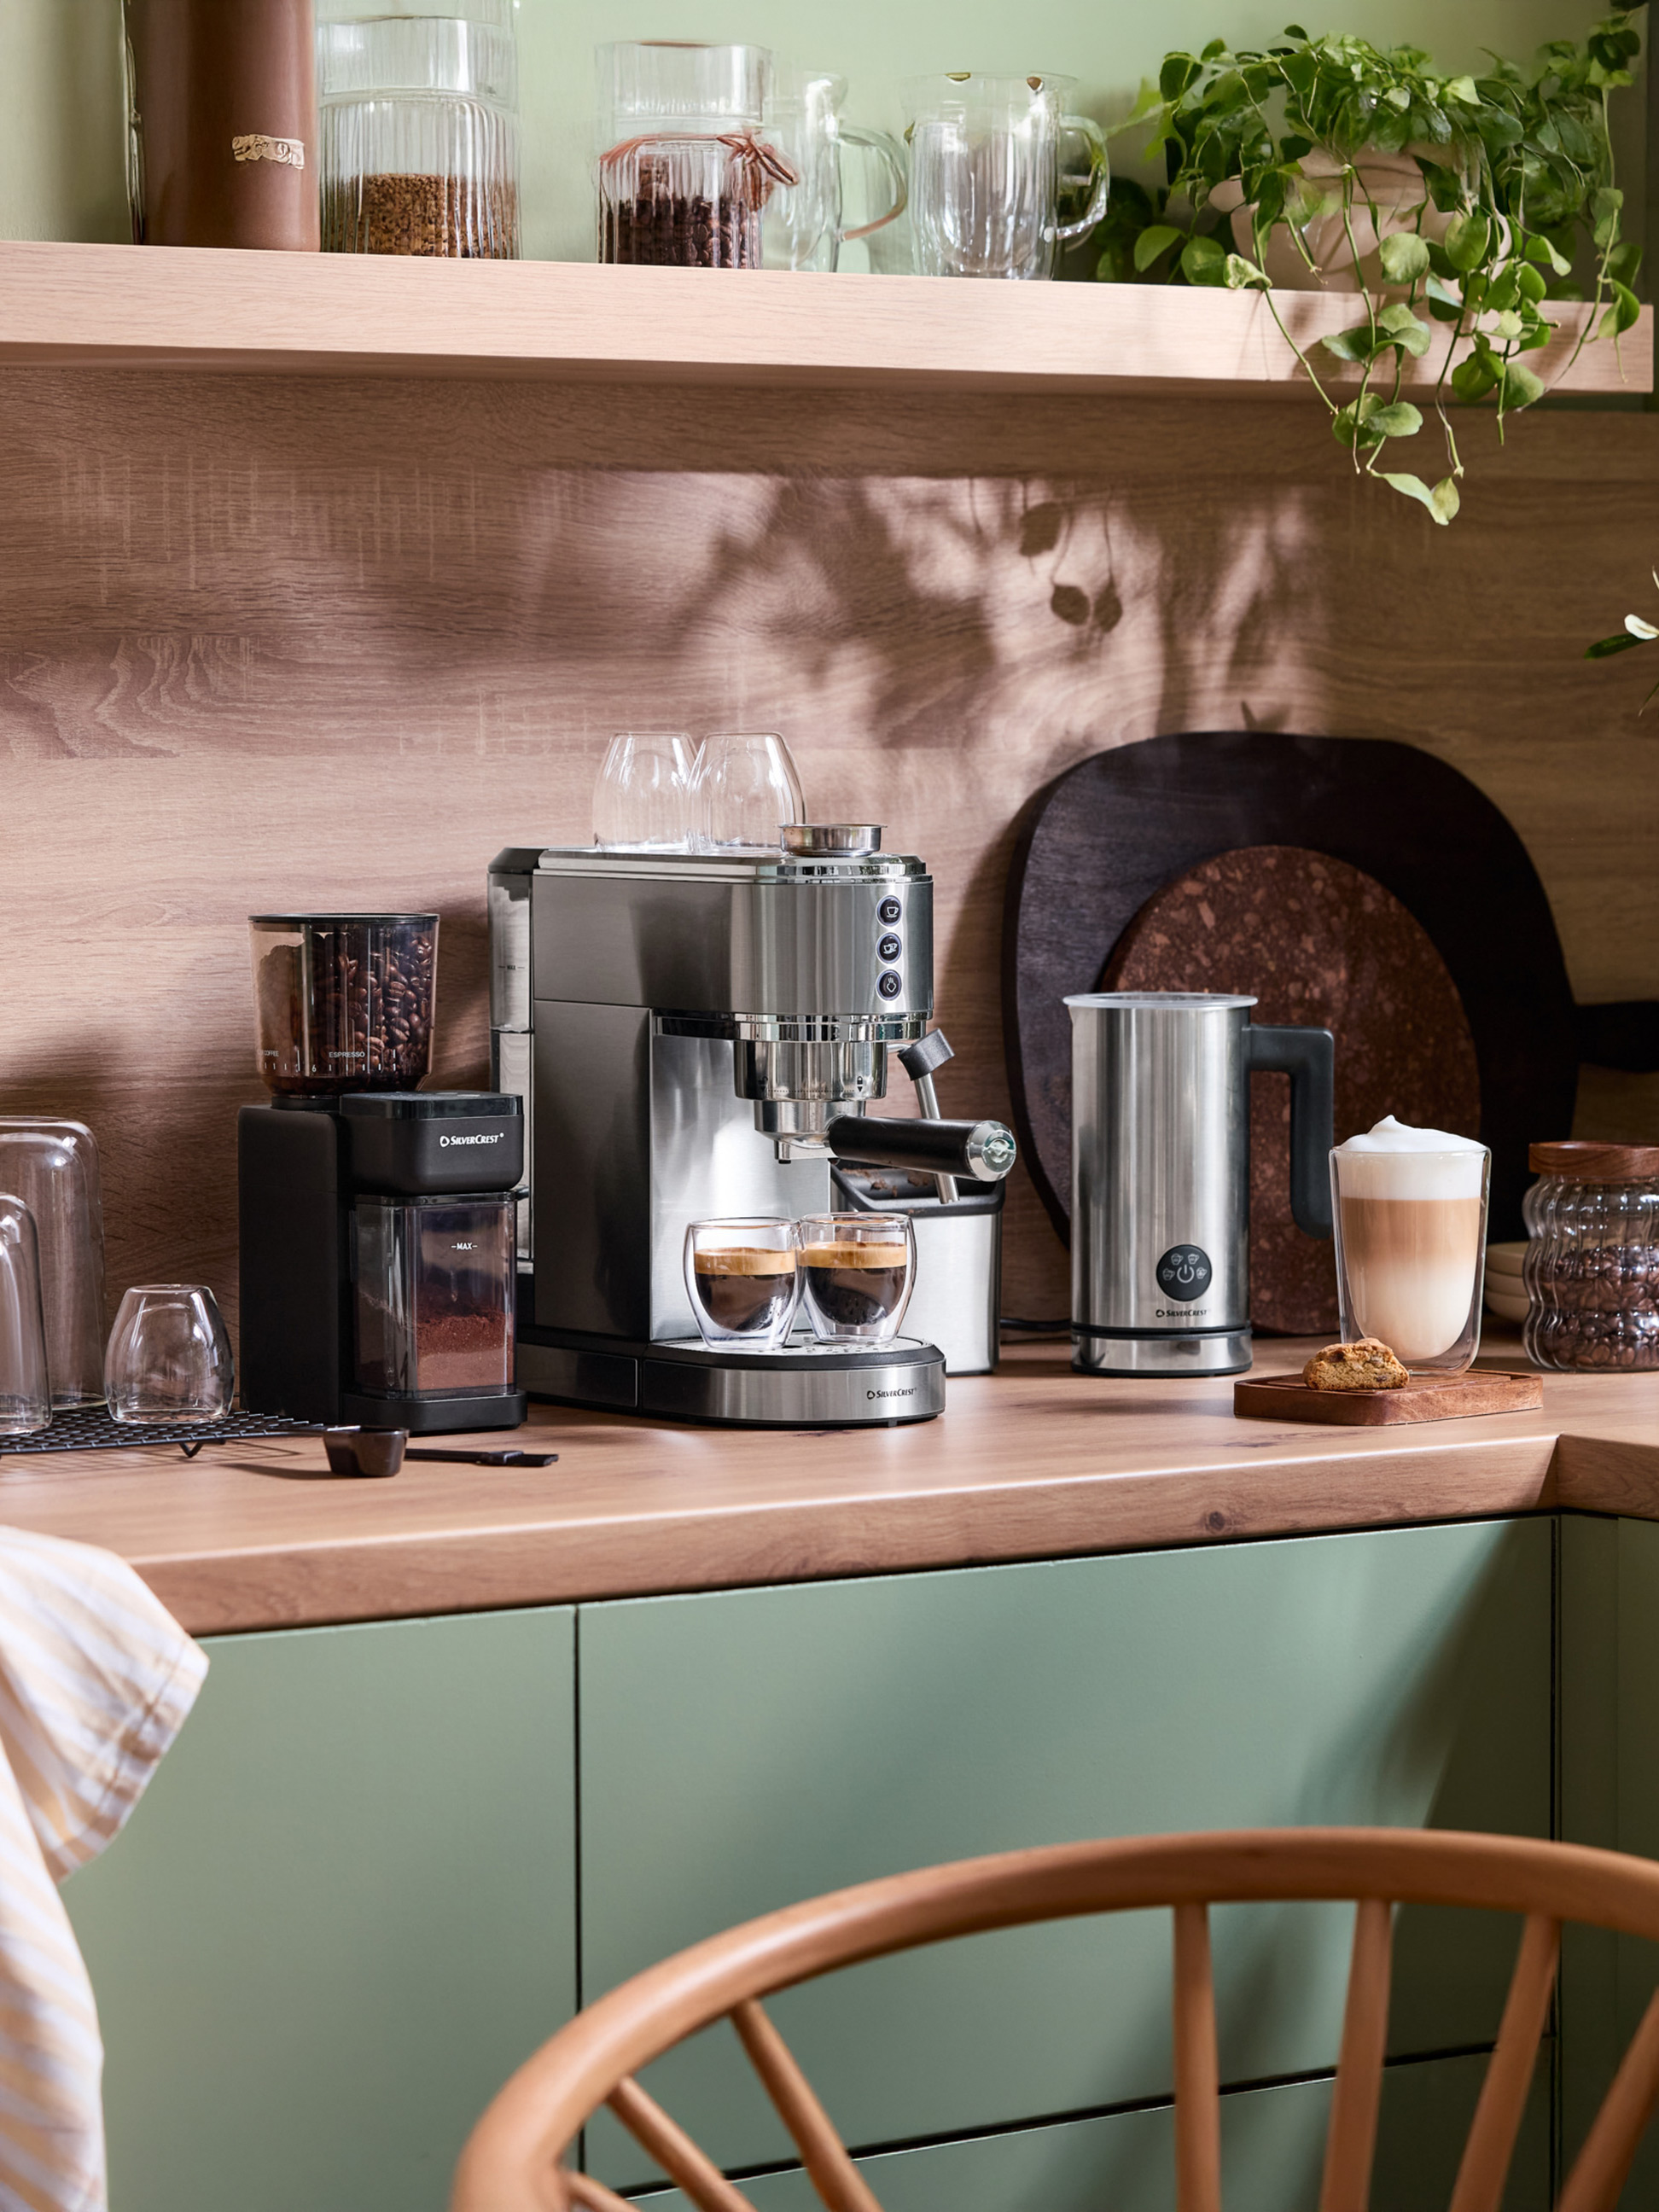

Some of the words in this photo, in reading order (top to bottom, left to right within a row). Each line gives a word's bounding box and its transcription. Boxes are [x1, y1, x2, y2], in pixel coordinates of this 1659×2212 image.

[311, 1064, 317, 1073] 6
[450, 1134, 499, 1145] SILVERCREST
[457, 1242, 473, 1250] MAX
[1166, 1309, 1208, 1318] SILVERCREST
[876, 1388, 915, 1399] SILVERCREST
